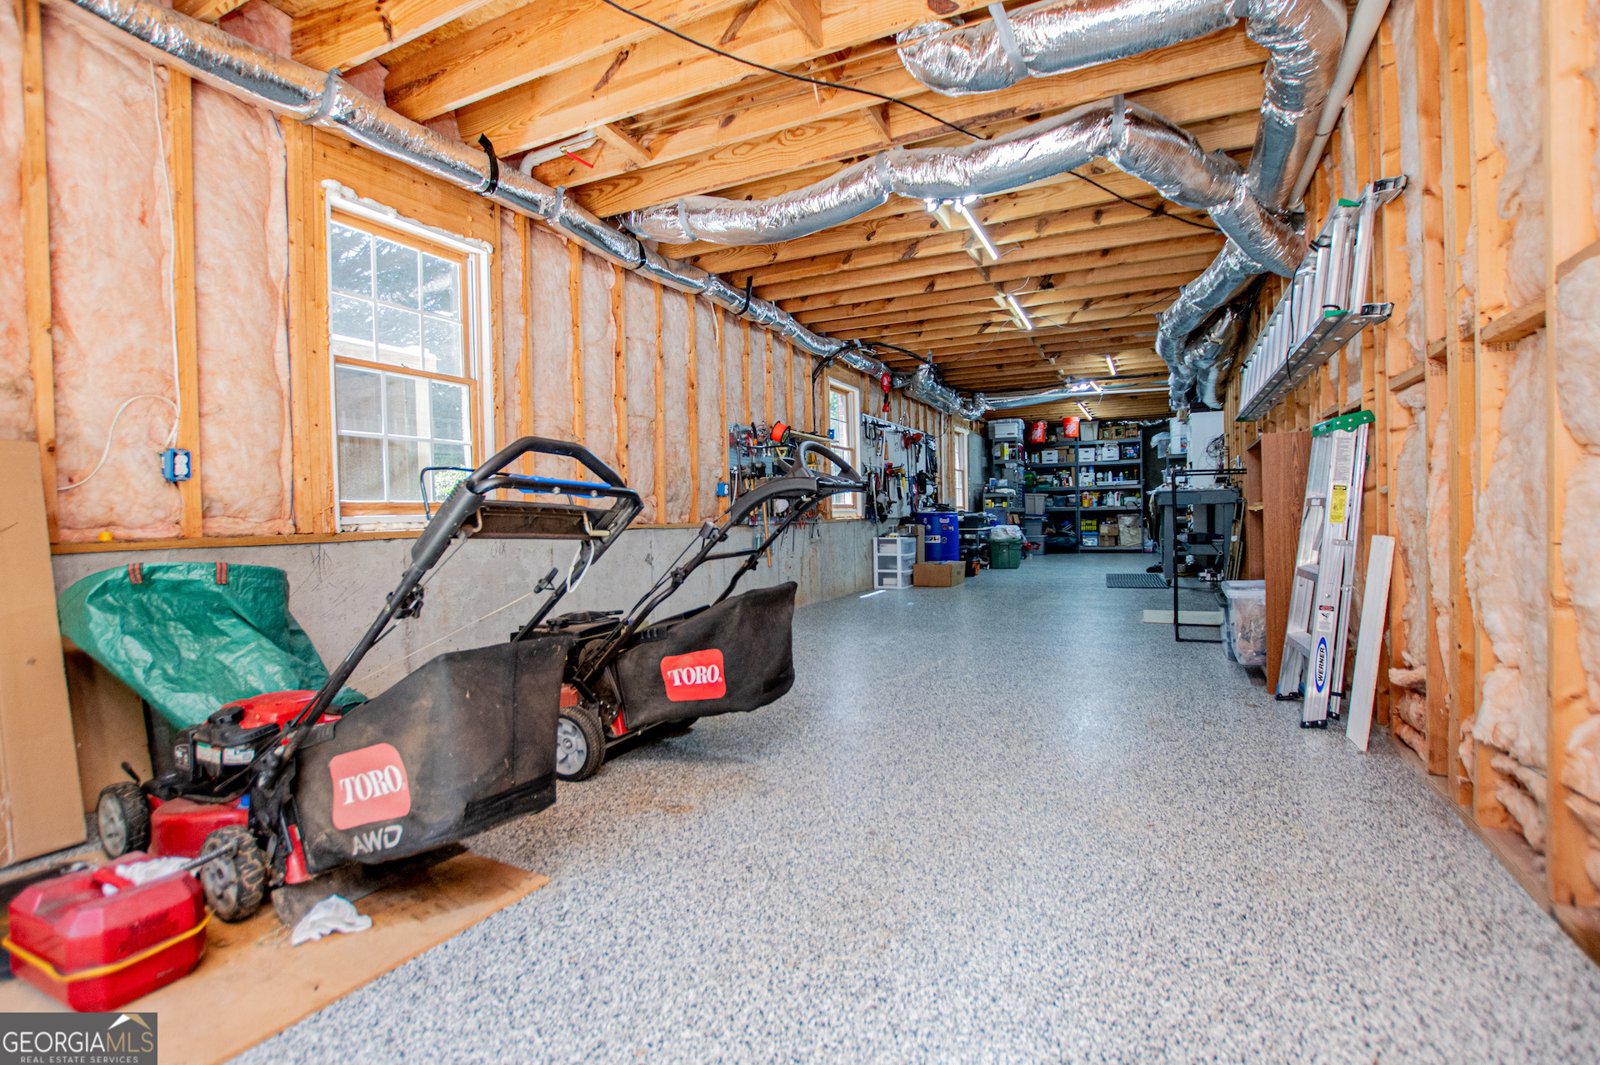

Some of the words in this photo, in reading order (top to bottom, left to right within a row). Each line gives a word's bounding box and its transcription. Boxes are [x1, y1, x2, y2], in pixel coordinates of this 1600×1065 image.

[1317, 647, 1325, 682] WERNER
[339, 764, 403, 806] TORO
[351, 824, 403, 857] AWD
